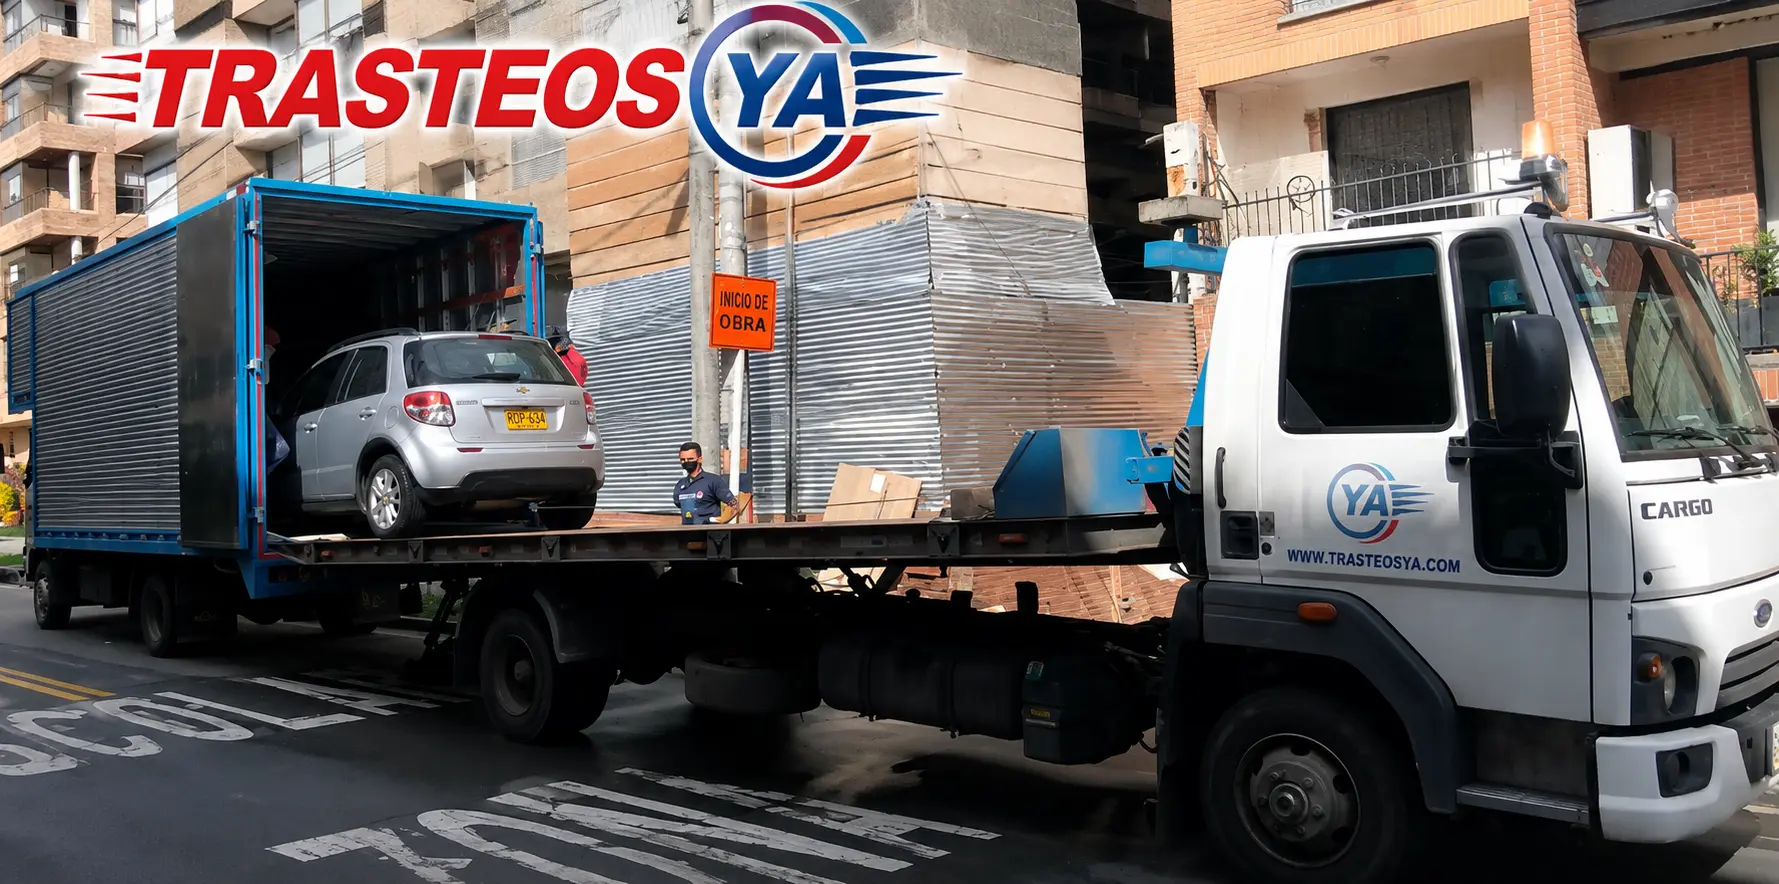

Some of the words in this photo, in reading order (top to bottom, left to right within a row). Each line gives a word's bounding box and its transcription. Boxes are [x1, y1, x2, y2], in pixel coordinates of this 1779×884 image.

[720, 291, 752, 309] INICIO
[755, 294, 769, 310] DE
[719, 314, 766, 333] OBRA
[1341, 483, 1389, 517] YA
[1640, 498, 1713, 520] CARGO
[1287, 549, 1461, 573] WWW.TRASTEOSYA.COM
